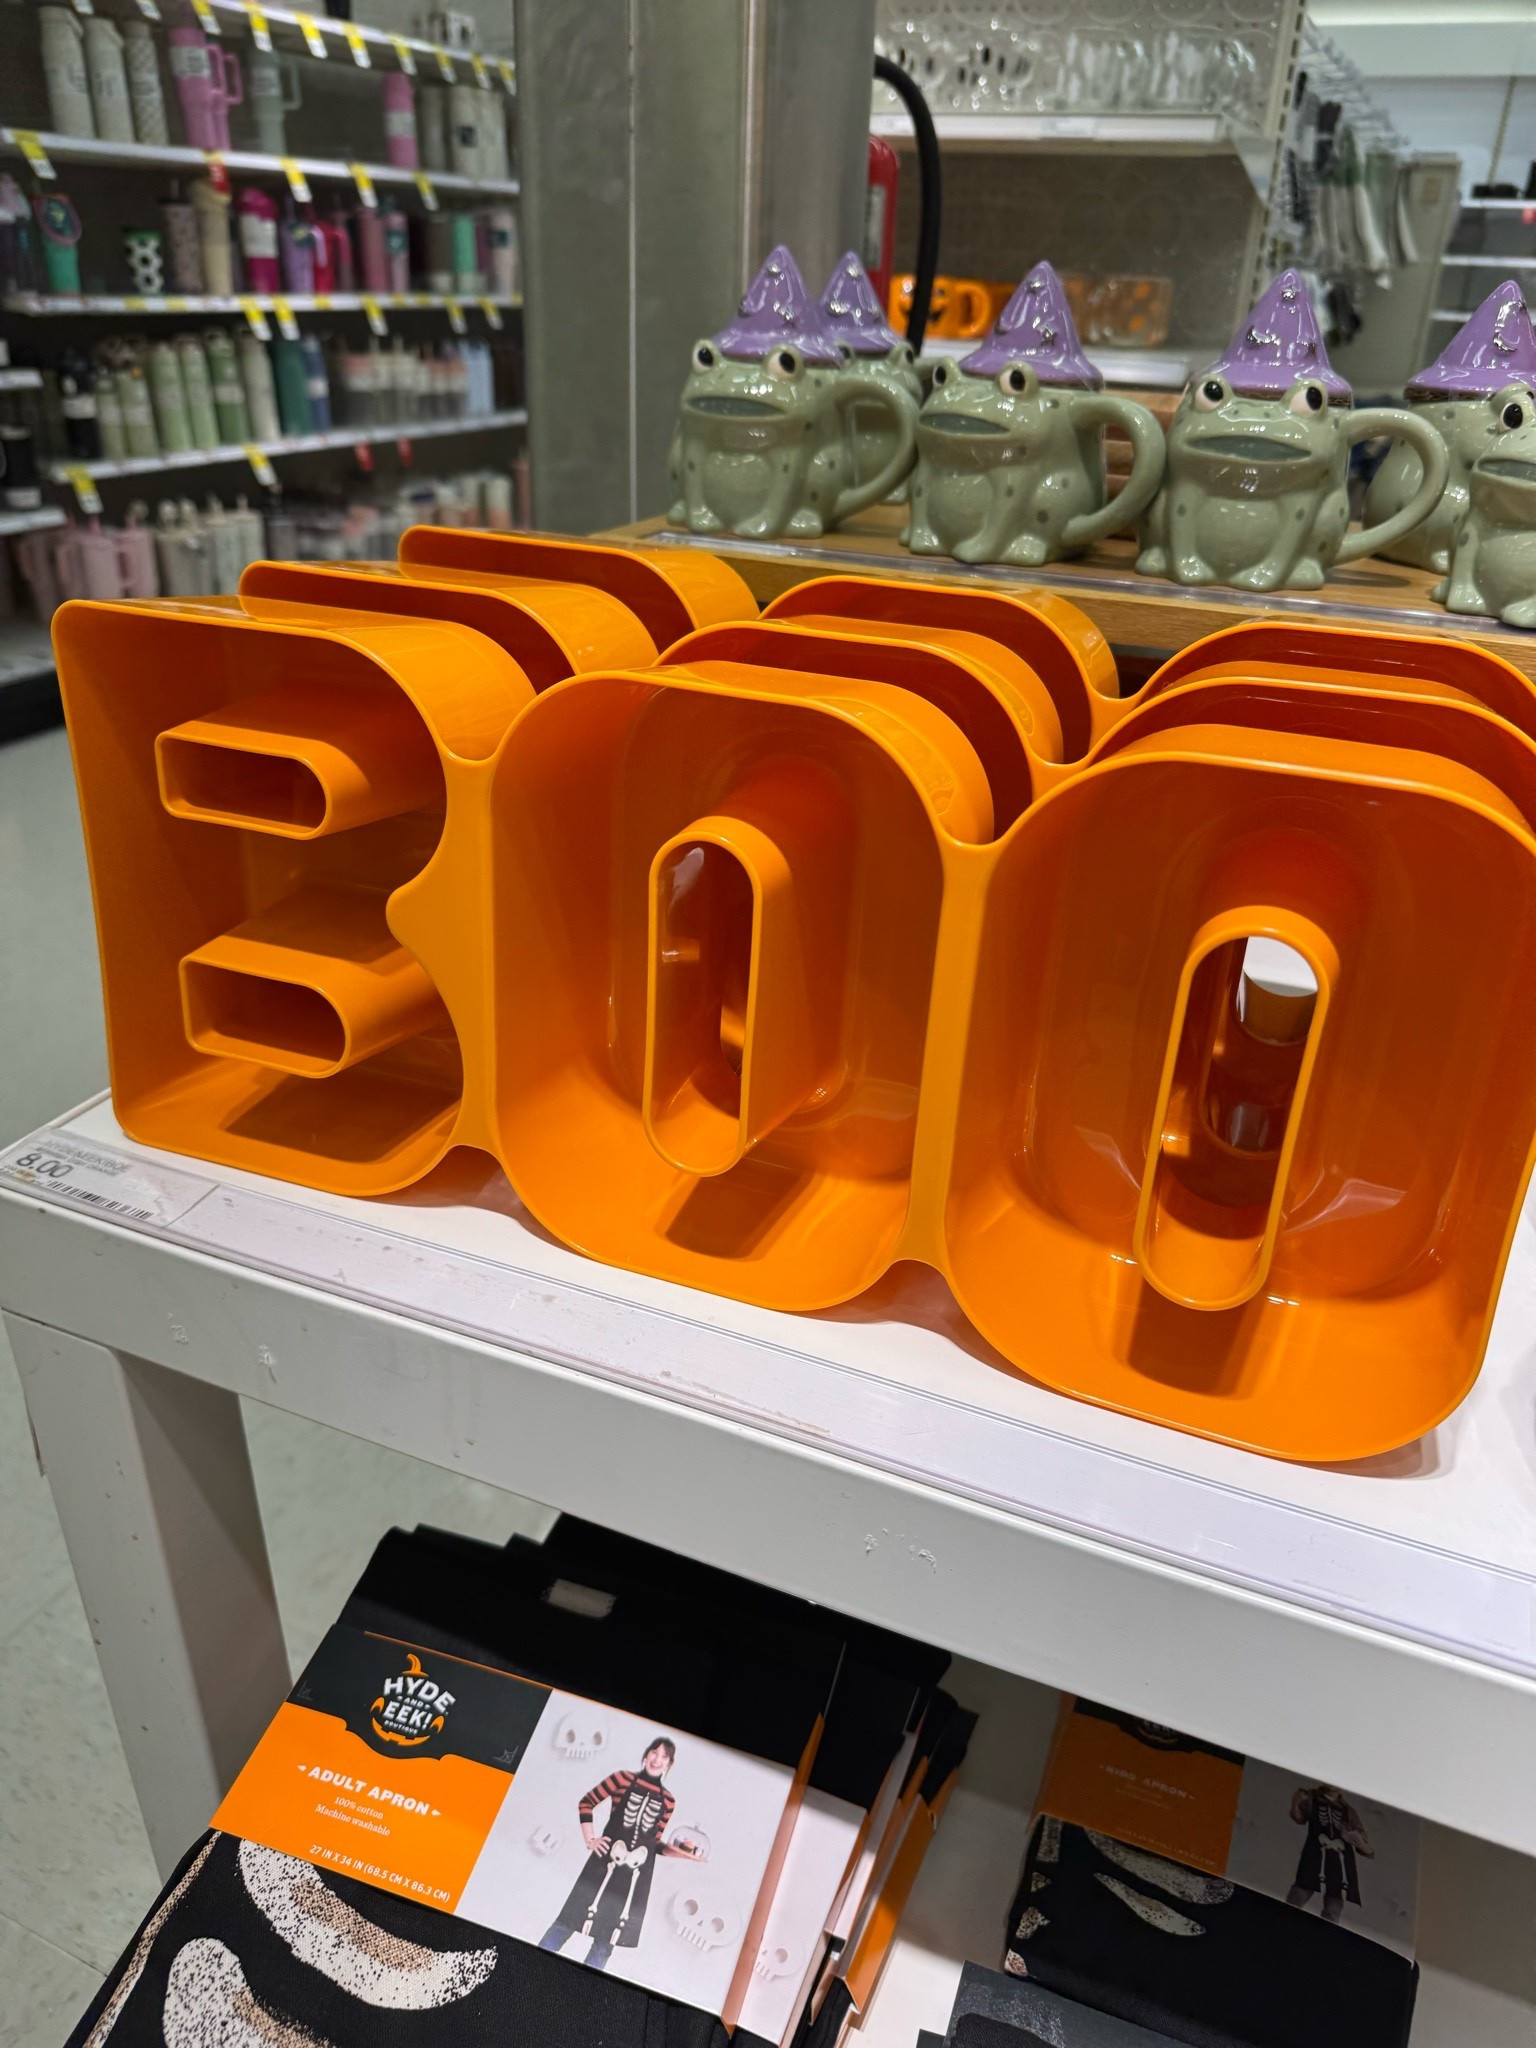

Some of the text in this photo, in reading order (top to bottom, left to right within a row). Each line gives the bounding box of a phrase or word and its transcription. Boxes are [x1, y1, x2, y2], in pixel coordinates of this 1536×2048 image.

[16, 1153, 74, 1178] 8.00
[383, 1675, 457, 1714] HYDE
[403, 1698, 424, 1709] AND
[382, 1700, 433, 1731] EEK!
[383, 1719, 419, 1735] BOUTIQUE
[308, 1766, 430, 1815] ADULT APRON
[1141, 1777, 1187, 1799] APRON
[315, 1804, 390, 1837] Machine washable
[334, 1796, 384, 1820] 100% cotton
[309, 1844, 451, 1903] 27 IN X 34 IN (68.5 CM X 86.3 CM)
